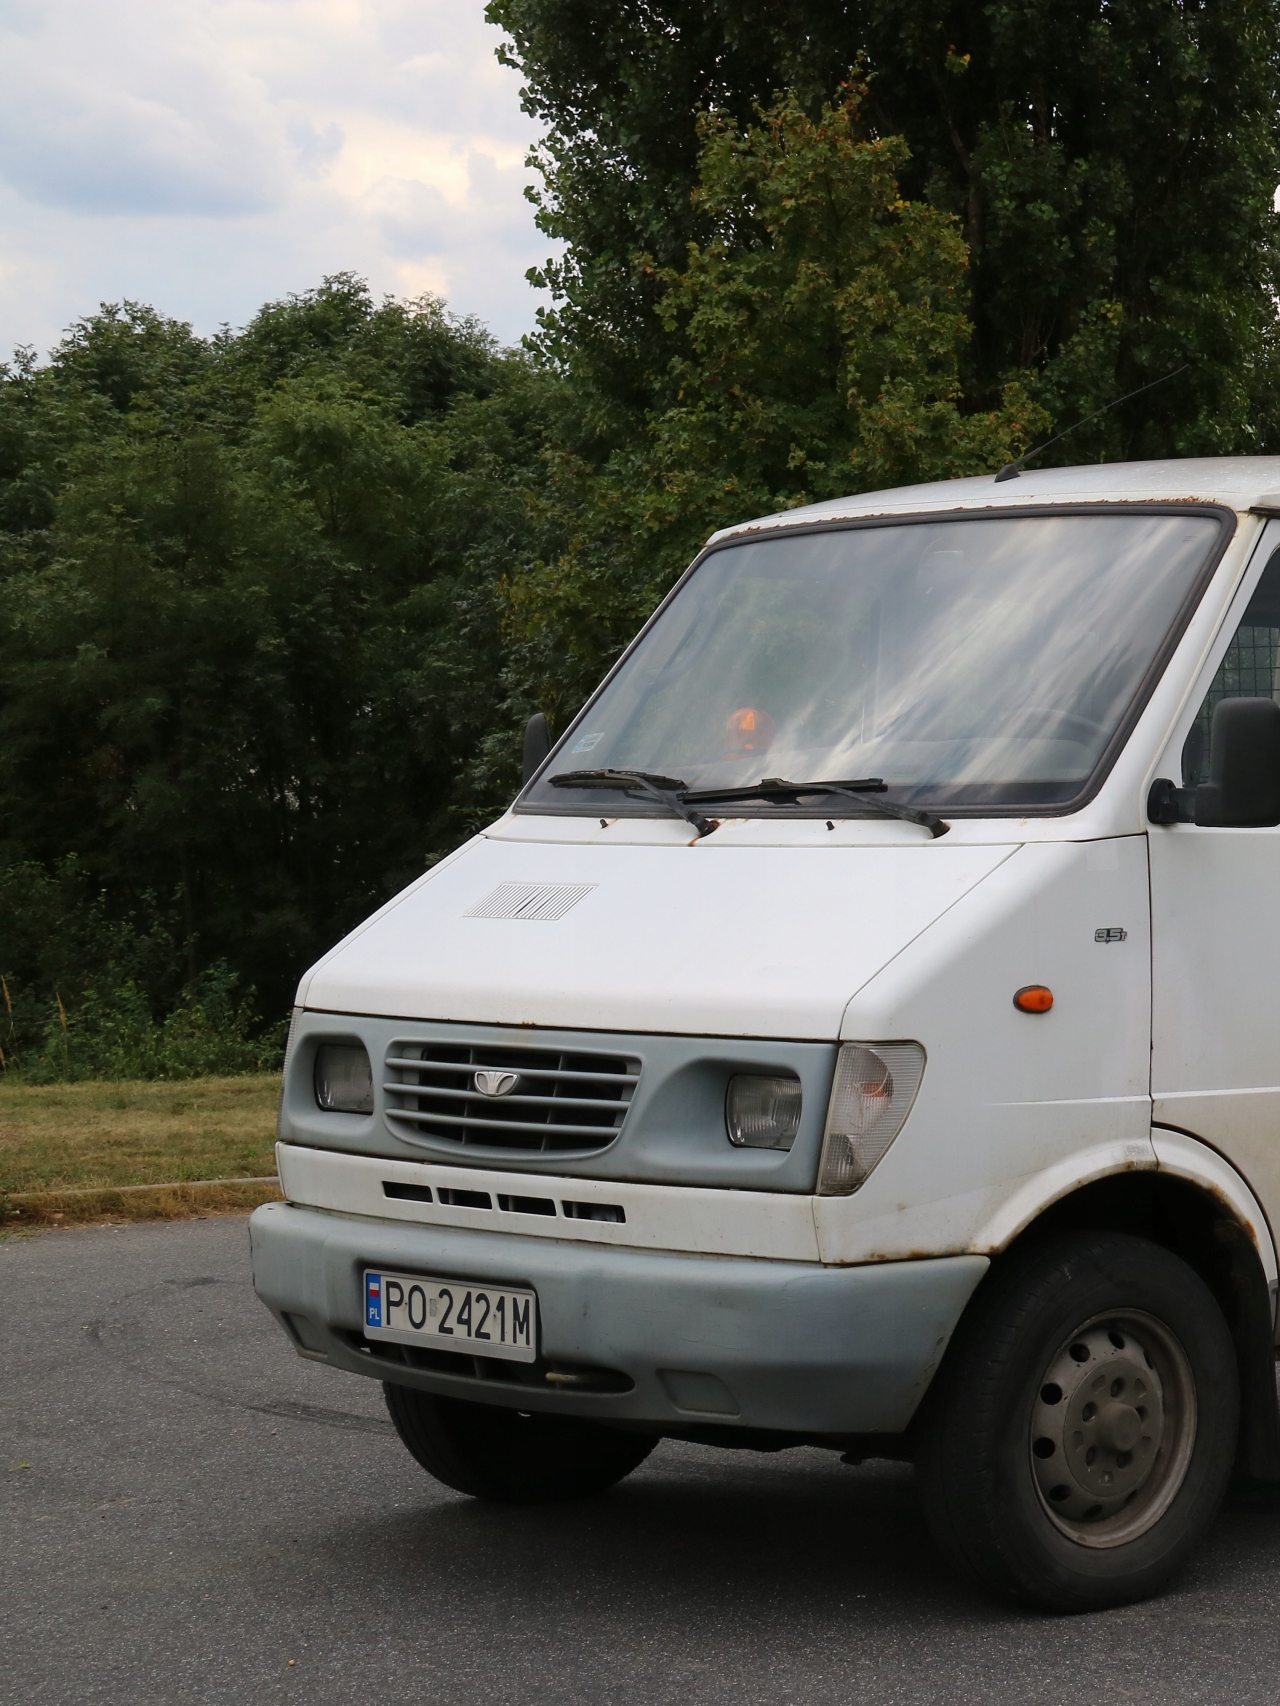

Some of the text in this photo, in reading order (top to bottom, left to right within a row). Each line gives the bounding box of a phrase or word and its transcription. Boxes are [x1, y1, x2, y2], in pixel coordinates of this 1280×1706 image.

[370, 1307, 380, 1320] PL
[385, 1280, 531, 1346] PO 2421M
